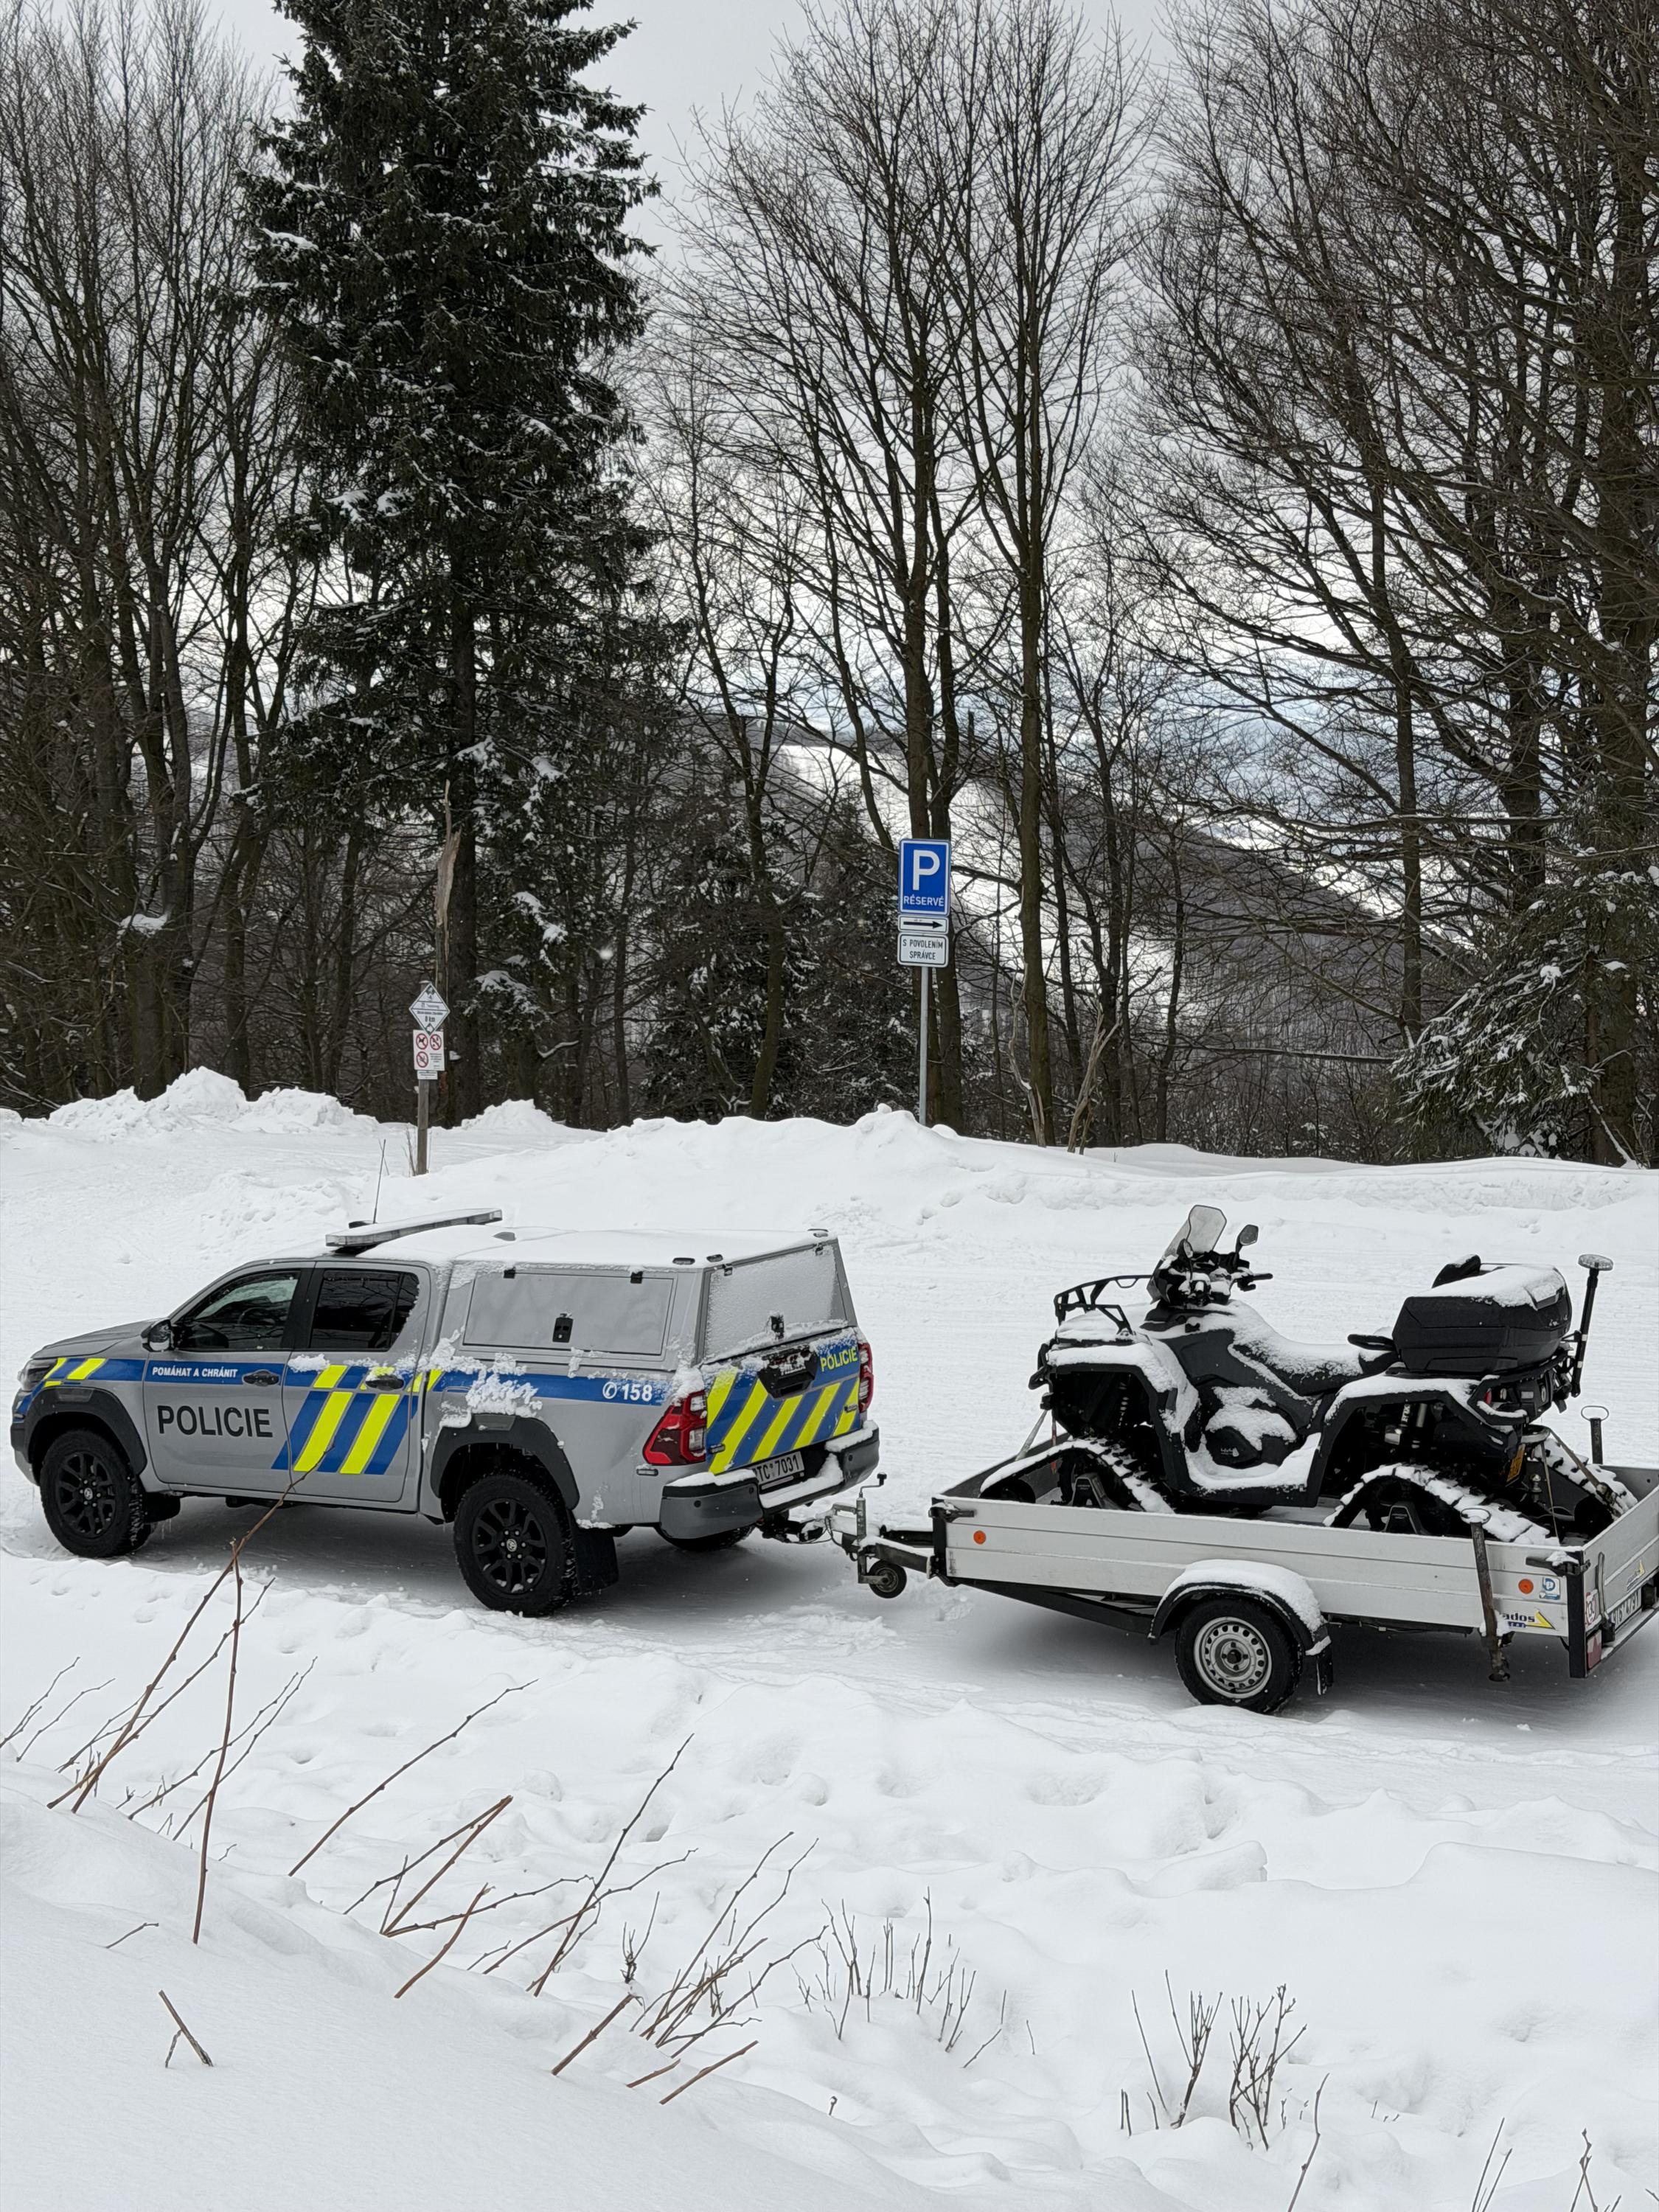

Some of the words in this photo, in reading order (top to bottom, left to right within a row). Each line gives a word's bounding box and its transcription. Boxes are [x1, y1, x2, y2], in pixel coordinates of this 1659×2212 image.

[913, 849, 940, 891] P
[904, 894, 944, 906] RÉSERVÉ
[902, 939, 907, 947] S
[909, 939, 943, 949] POVOLENÍM
[909, 949, 936, 960] SPRÁVCE
[820, 1346, 858, 1372] POLICIE
[153, 1366, 192, 1377] POMÁHAT
[193, 1368, 199, 1377] A
[201, 1366, 238, 1378] CHRÁNIT
[622, 1383, 653, 1402] 158
[157, 1405, 273, 1438] POLICIE
[774, 1454, 799, 1476] 7031
[1502, 1613, 1534, 1622] ados
